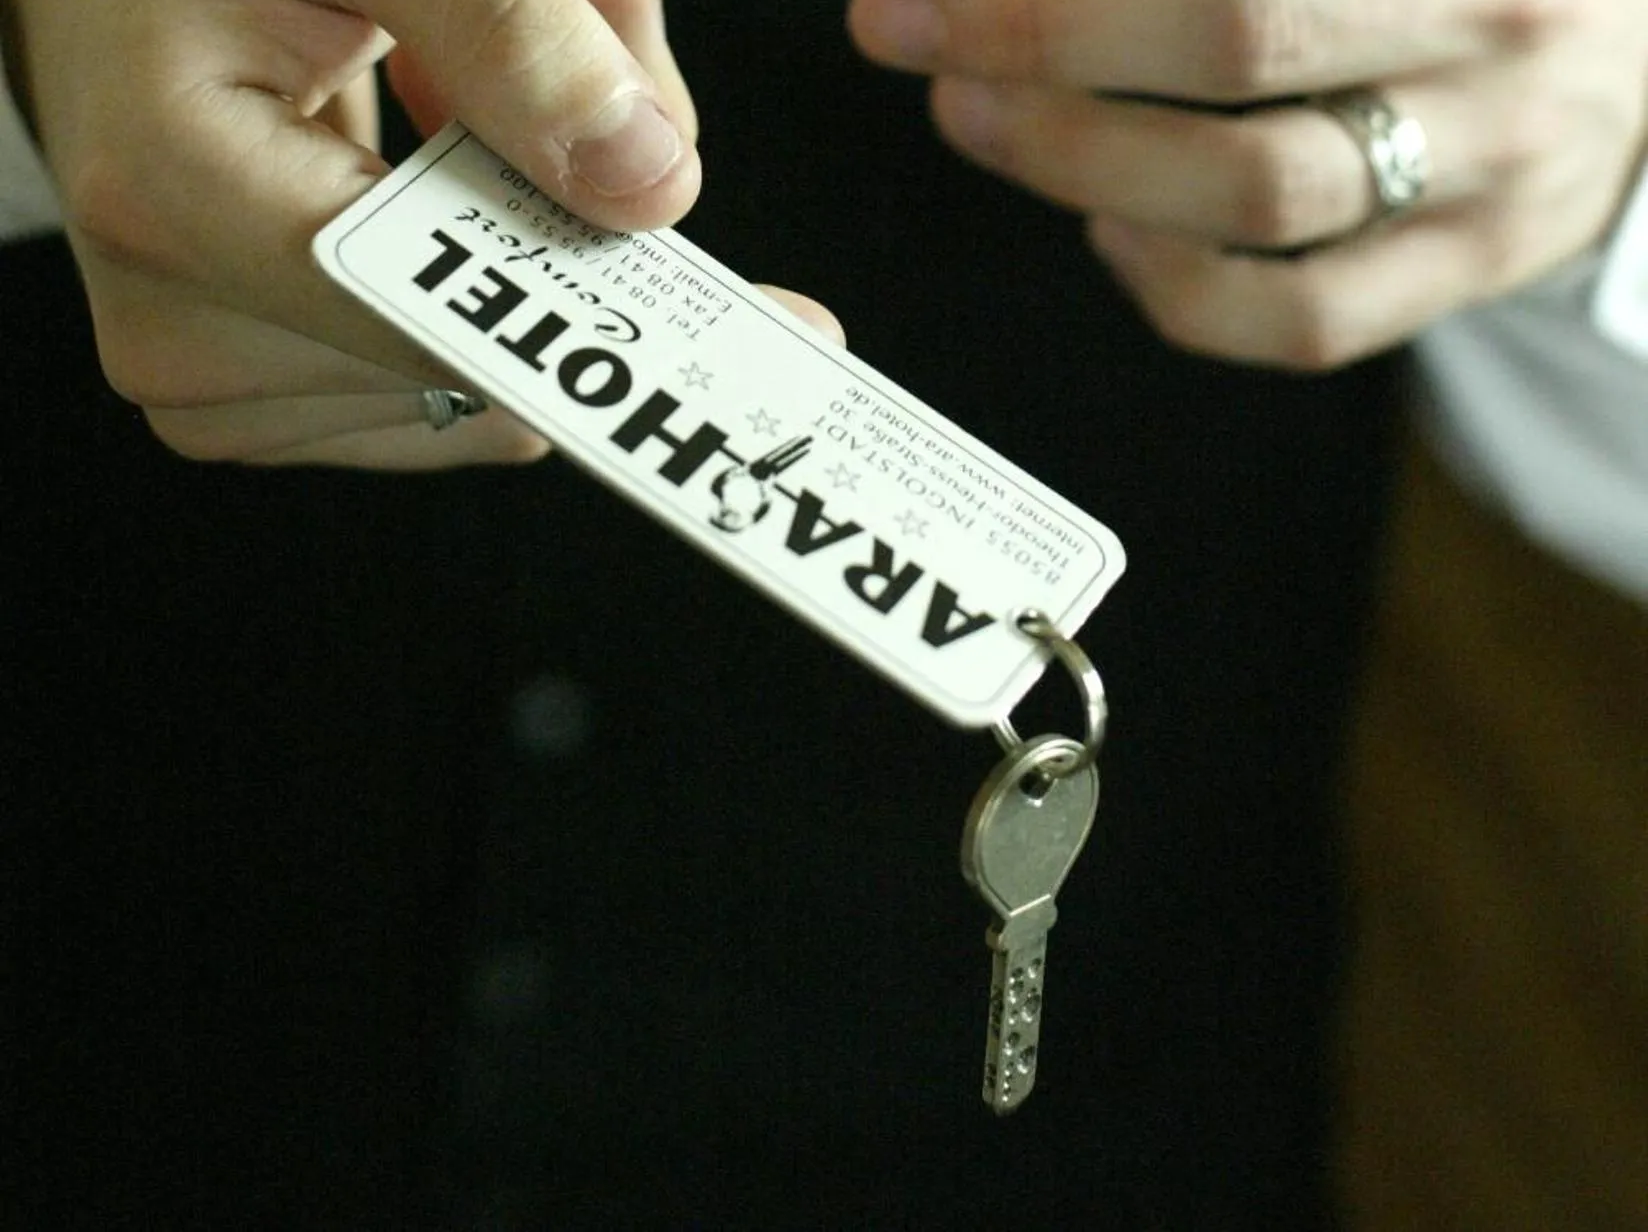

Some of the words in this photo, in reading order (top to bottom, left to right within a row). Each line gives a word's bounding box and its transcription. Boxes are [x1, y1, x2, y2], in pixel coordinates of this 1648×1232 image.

[453, 206, 643, 344] Comfort
[611, 225, 669, 272] info@
[669, 264, 733, 314] E-mail:
[412, 228, 728, 487] HOTEL
[680, 293, 719, 327] Fax
[827, 399, 857, 422] 30
[844, 385, 1006, 500] www.ara-hotel.de
[810, 413, 976, 530] INGOLSTADT
[861, 420, 1070, 570] Theodor-Heuss-Straße
[785, 488, 995, 648] ARA
